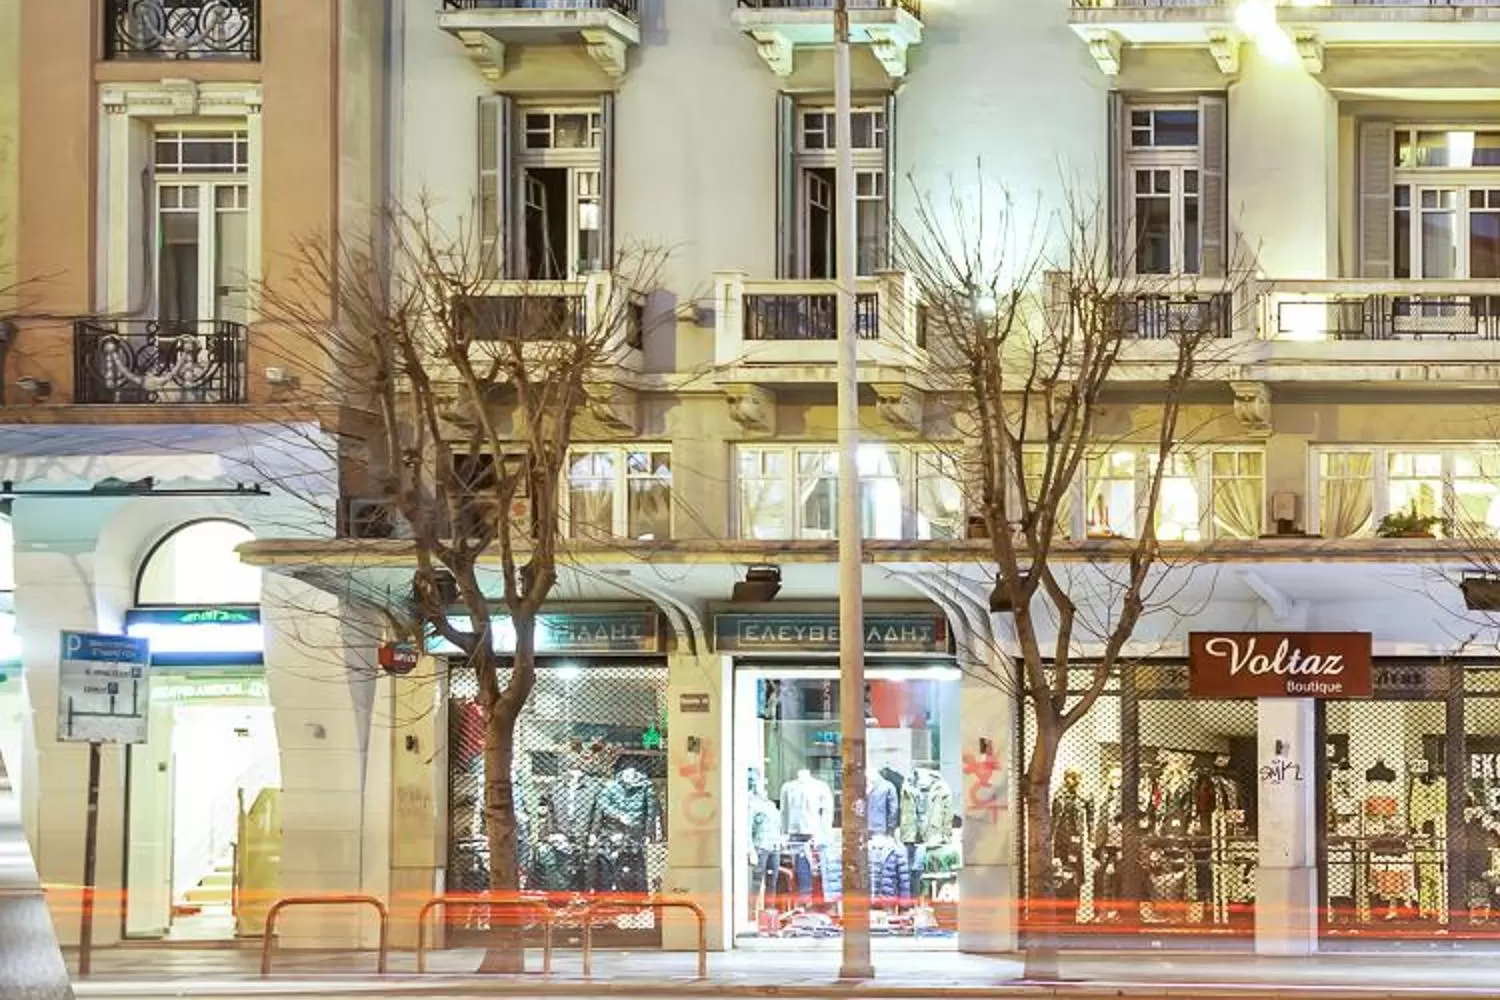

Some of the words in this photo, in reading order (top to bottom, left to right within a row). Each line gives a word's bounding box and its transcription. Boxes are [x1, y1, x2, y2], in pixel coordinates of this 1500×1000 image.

[745, 625, 932, 642] ΕΛΕΥΘΕΑΔΗΣ
[1205, 637, 1344, 676] Voltaz
[1286, 680, 1343, 693] Boutique
